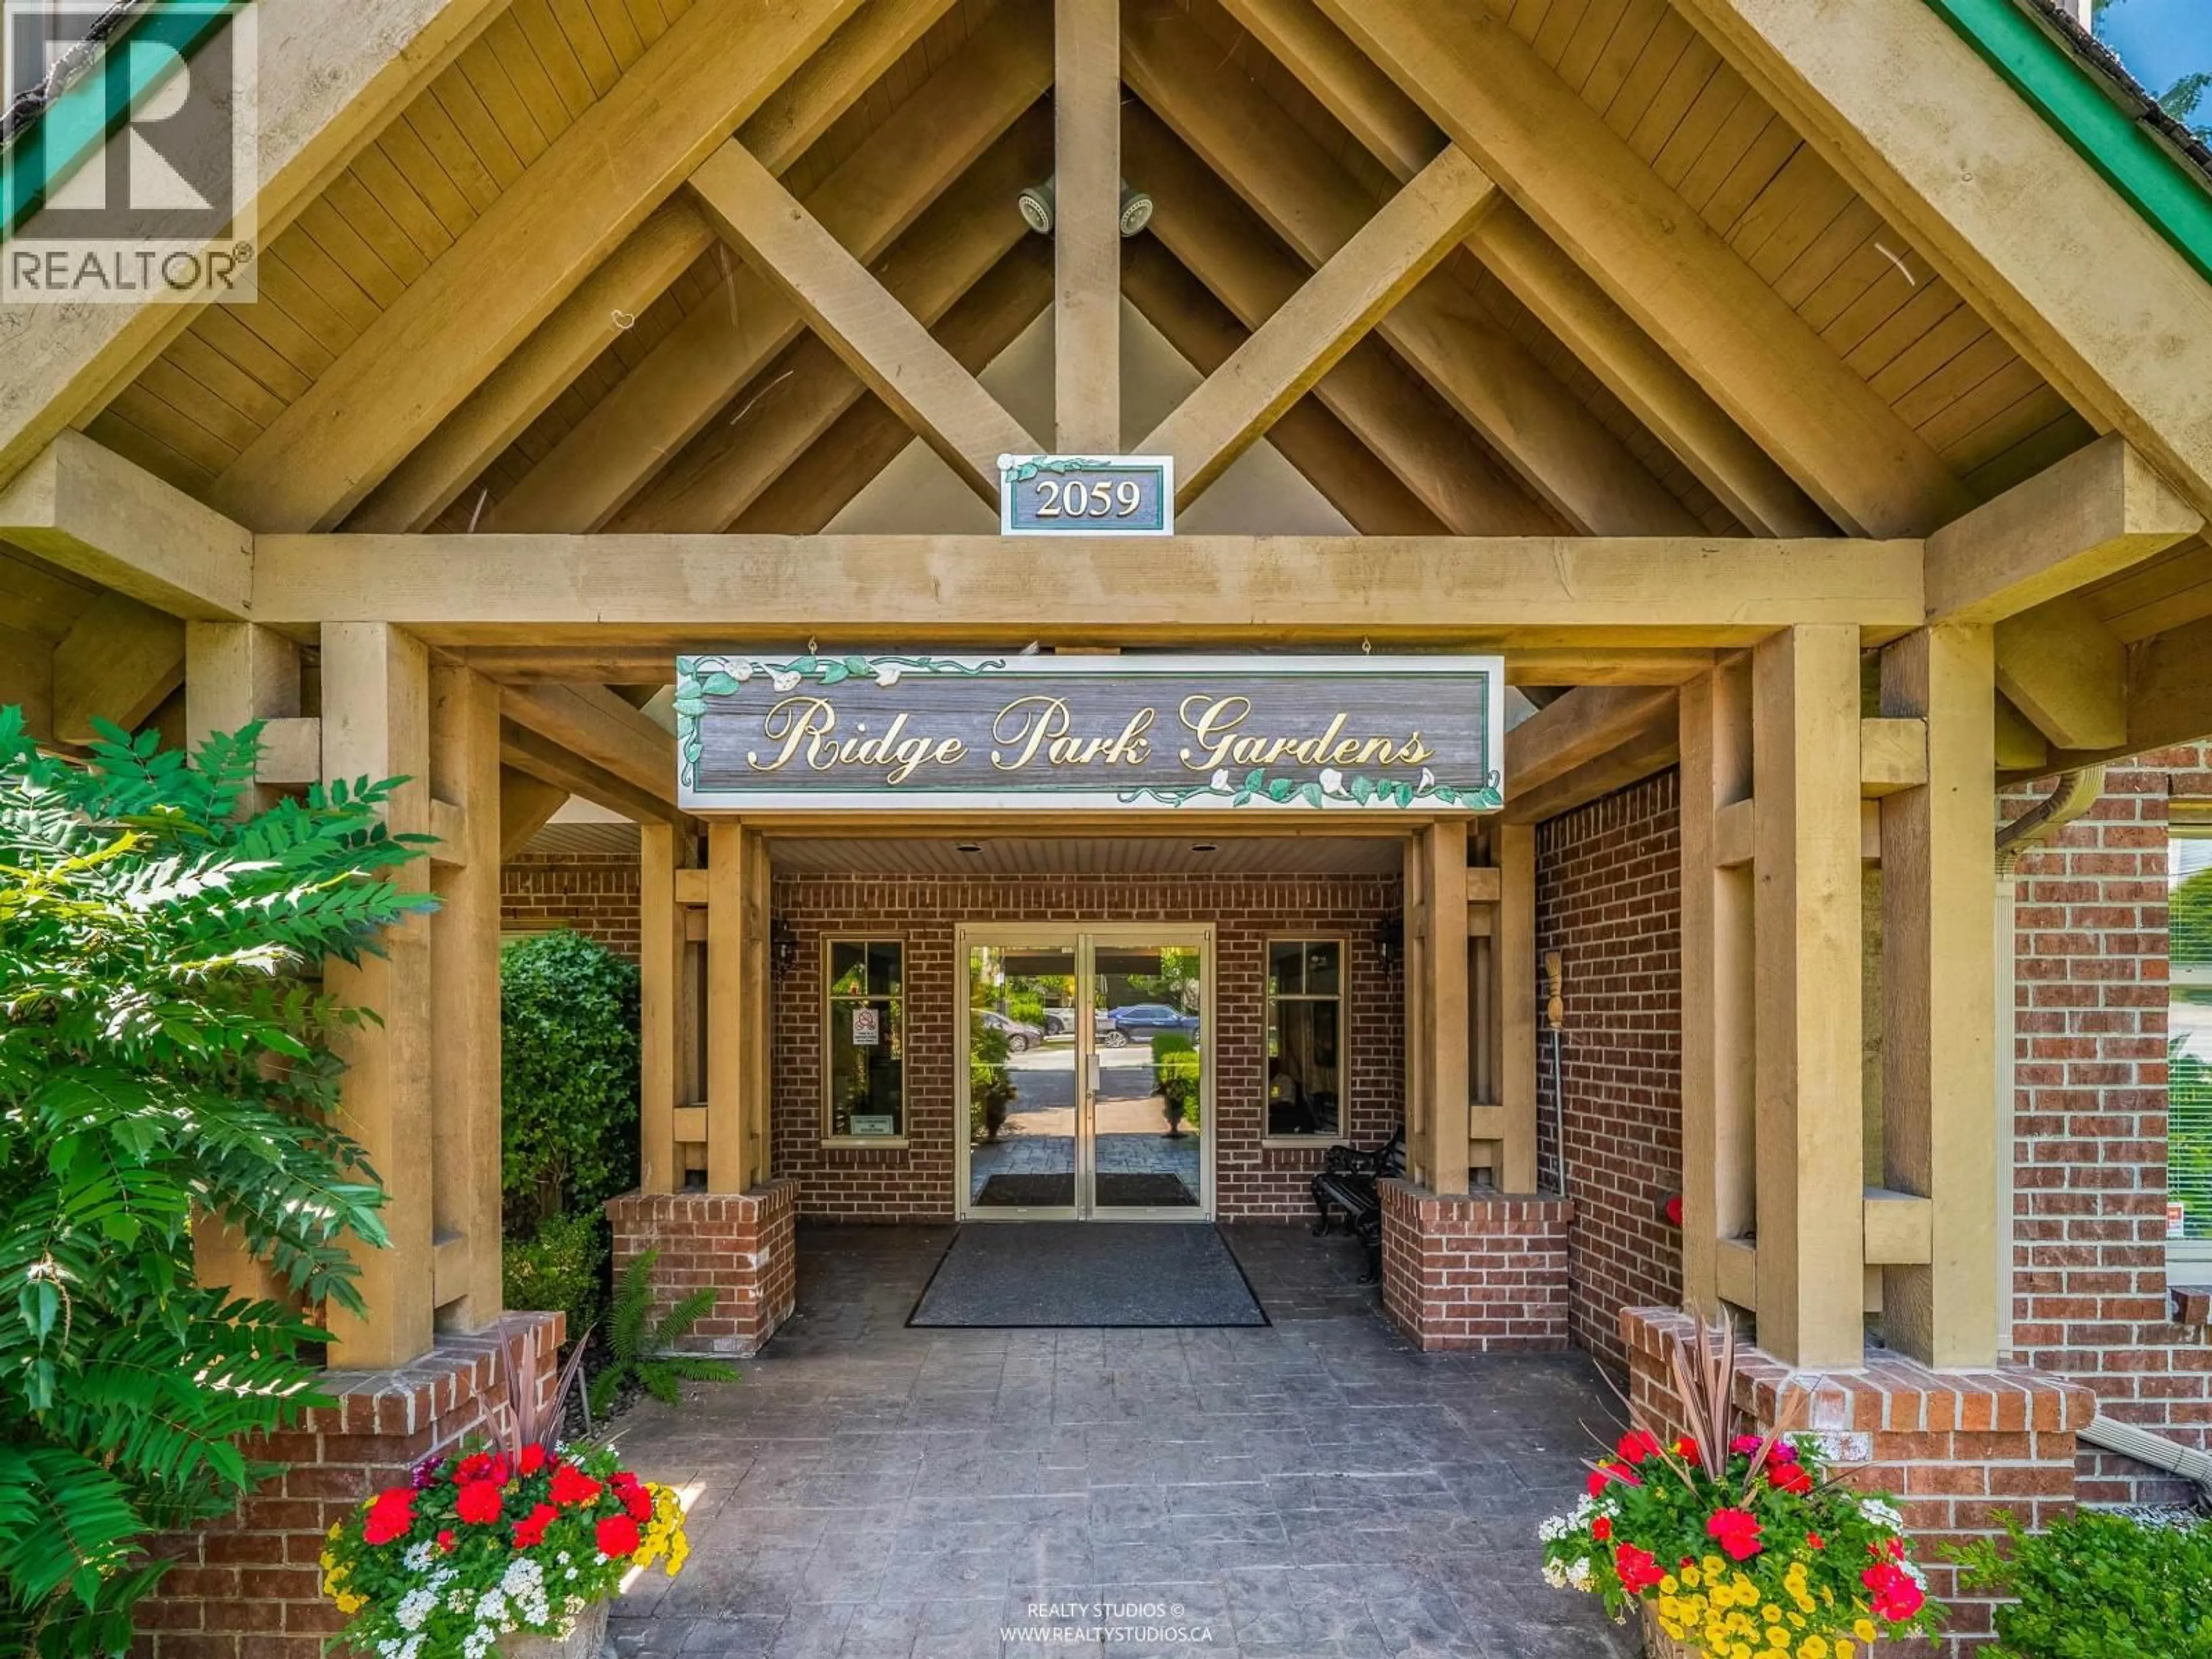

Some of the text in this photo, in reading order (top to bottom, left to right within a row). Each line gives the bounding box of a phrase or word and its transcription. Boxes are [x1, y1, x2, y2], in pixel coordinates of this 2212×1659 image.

[1036, 480, 1141, 518] 2059
[748, 694, 1436, 785] Ridge Park Gardens
